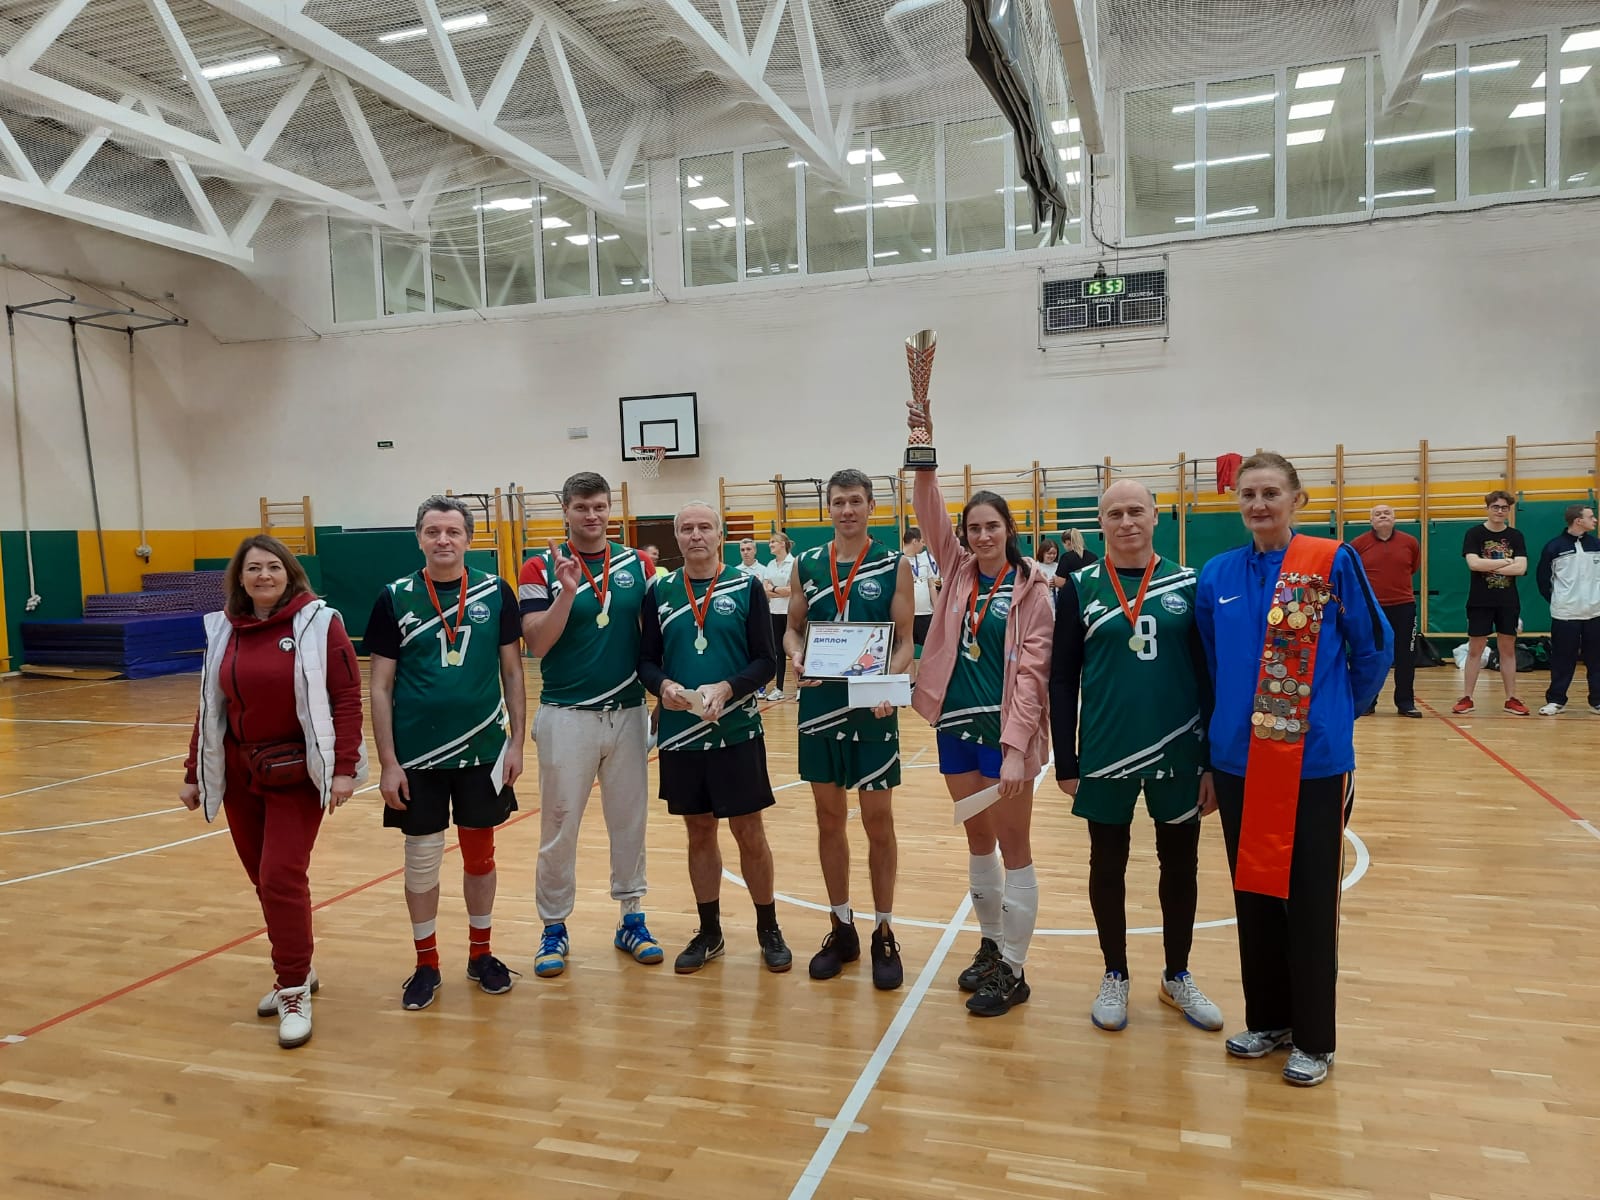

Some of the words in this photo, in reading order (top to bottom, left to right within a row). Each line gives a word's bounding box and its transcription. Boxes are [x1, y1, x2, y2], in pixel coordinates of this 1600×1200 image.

[1088, 281, 1101, 294] 15
[1105, 279, 1123, 293] 53
[435, 624, 472, 667] 17
[1134, 614, 1158, 660] 8
